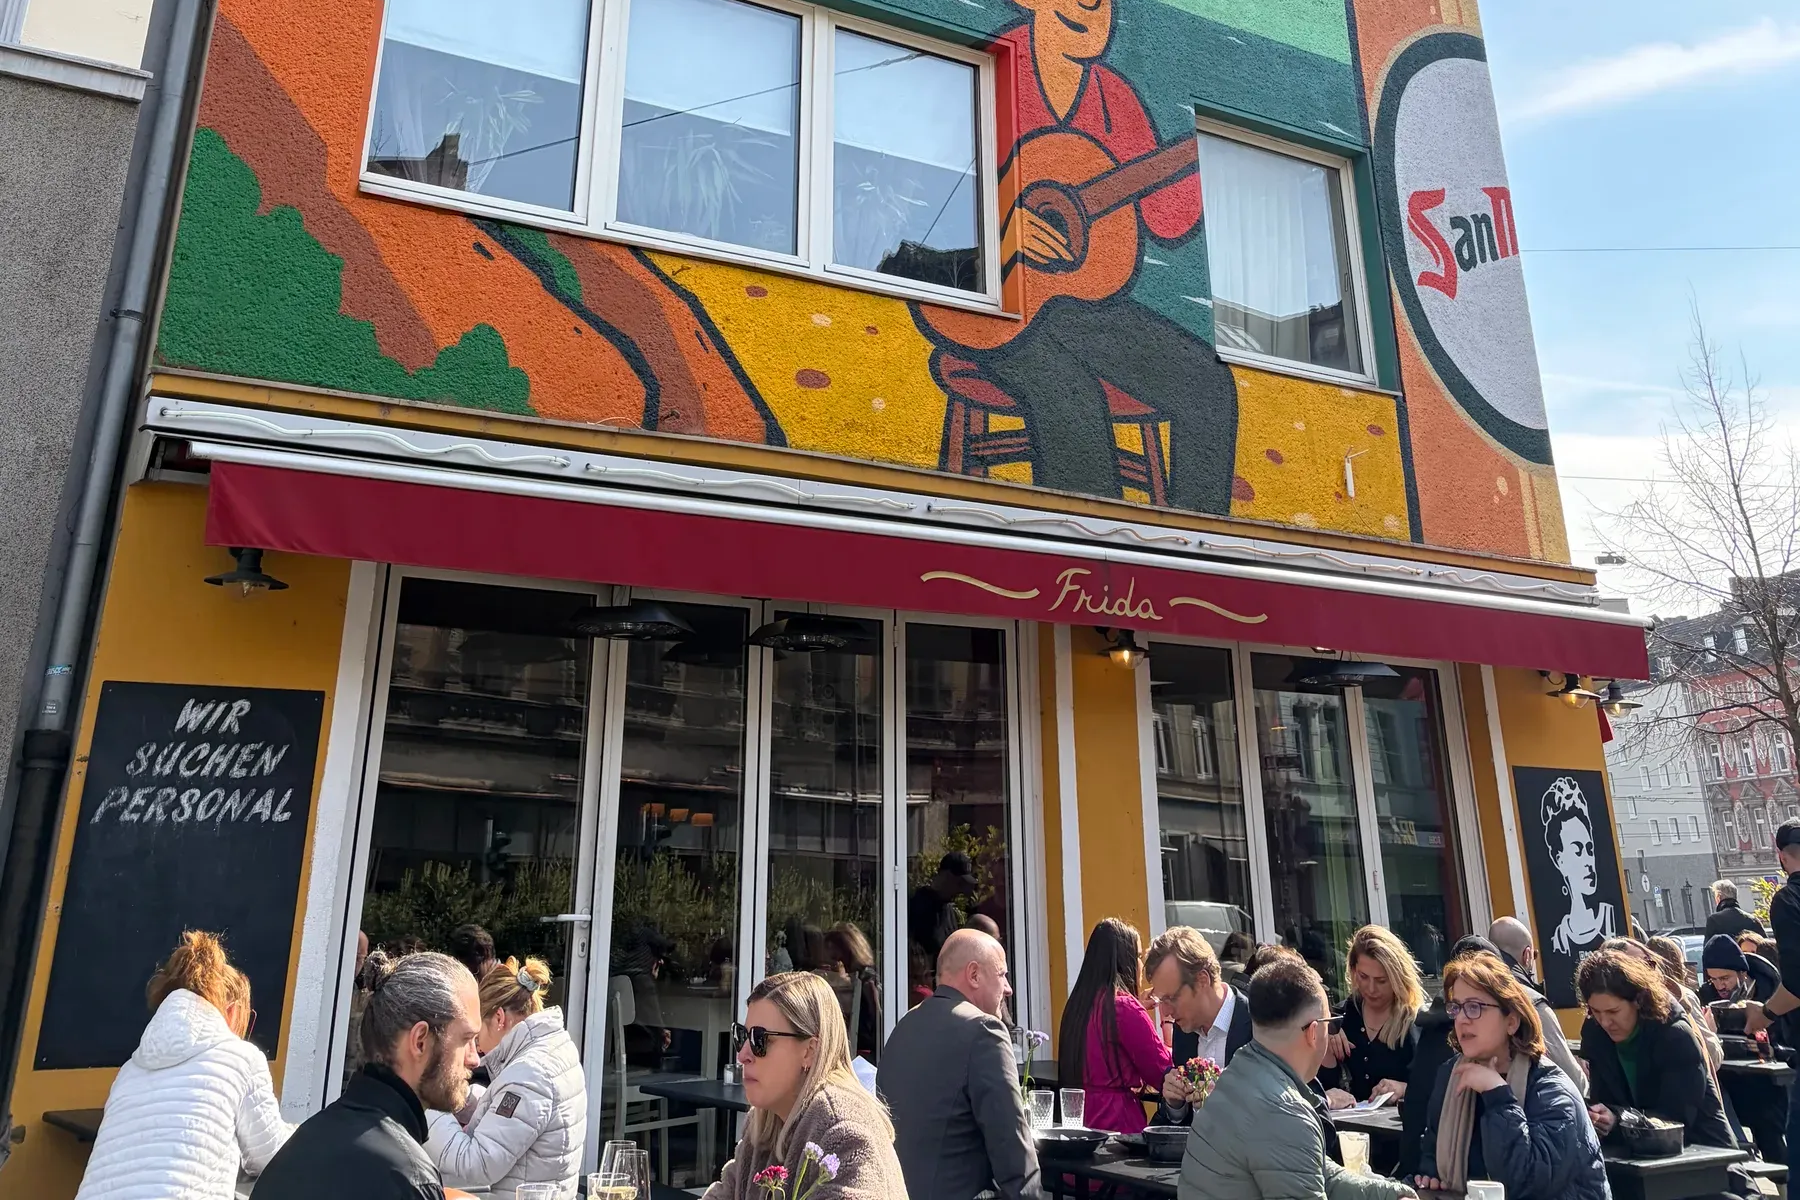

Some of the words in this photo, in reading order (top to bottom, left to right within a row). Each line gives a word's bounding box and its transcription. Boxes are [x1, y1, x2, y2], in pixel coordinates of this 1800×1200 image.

[1047, 567, 1164, 621] Frida
[174, 698, 252, 734] WIR
[125, 740, 290, 778] SUCHEN
[89, 785, 295, 825] PERSONAL
